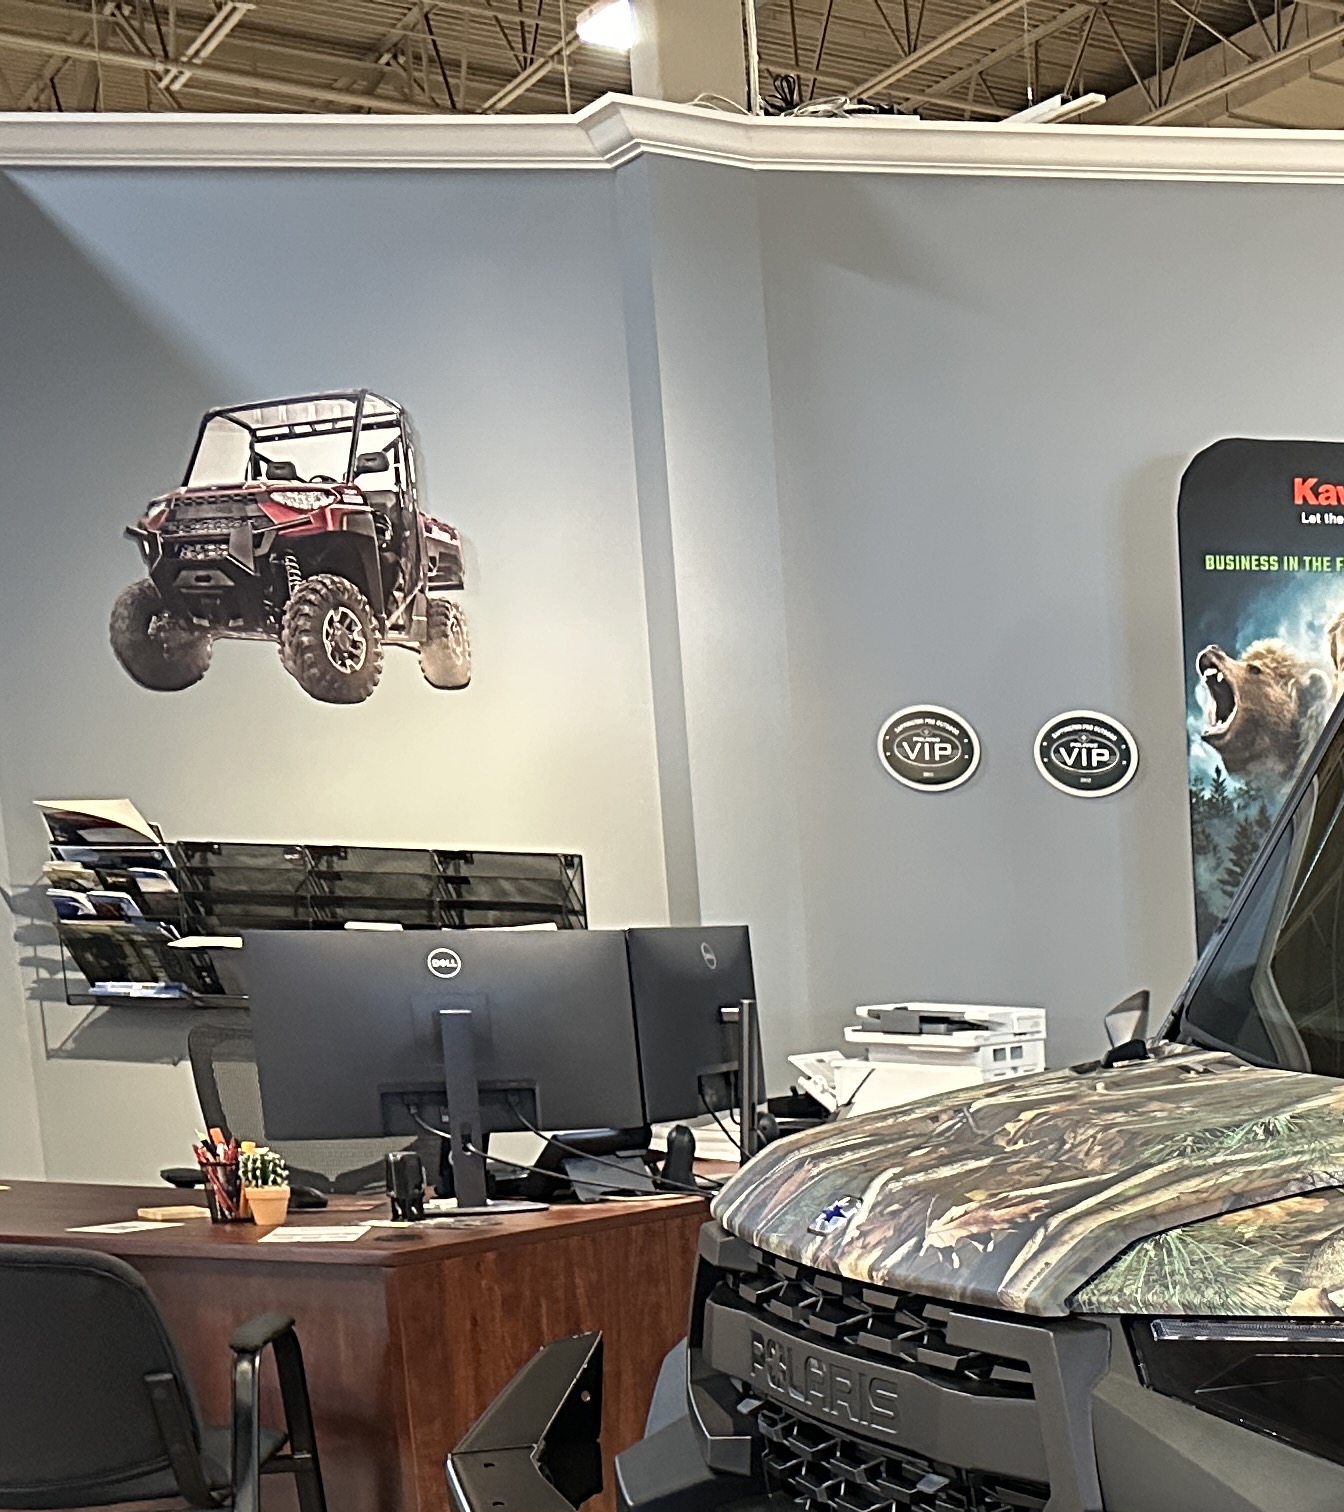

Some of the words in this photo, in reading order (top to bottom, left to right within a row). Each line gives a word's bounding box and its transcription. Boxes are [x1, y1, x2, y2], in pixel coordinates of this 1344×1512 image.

[1301, 511, 1321, 524] Let
[1324, 513, 1344, 525] the
[1205, 555, 1279, 572] BUSINESS
[1283, 556, 1299, 572] IN
[1303, 557, 1332, 573] THE
[902, 742, 952, 761] VIP
[1059, 747, 1110, 767] VIP
[431, 958, 459, 968] DELL
[751, 1329, 899, 1434] POLARIS
